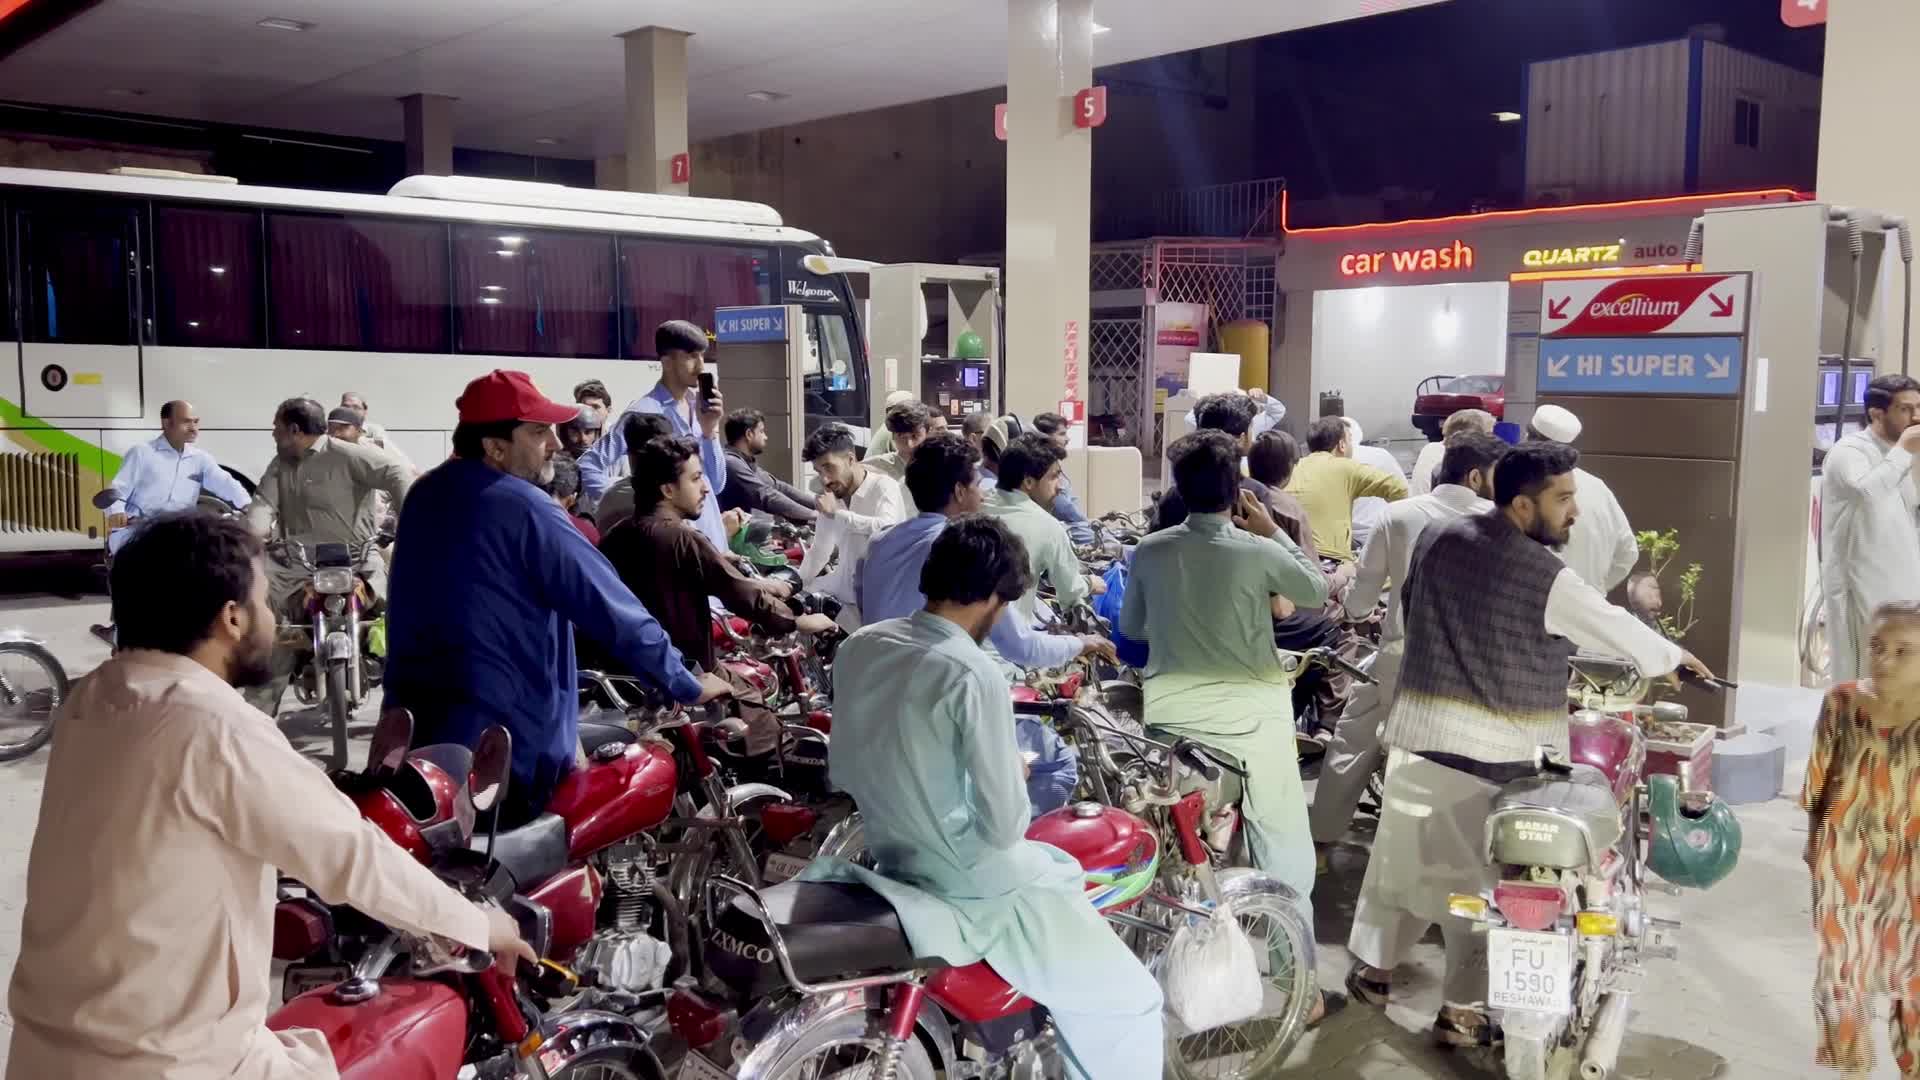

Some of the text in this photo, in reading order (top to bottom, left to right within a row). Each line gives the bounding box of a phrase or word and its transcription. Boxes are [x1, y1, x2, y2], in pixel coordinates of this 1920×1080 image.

[1083, 97, 1095, 118] 5
[1340, 240, 1474, 276] car wash
[1522, 244, 1621, 266] QUARTZ
[1633, 244, 1677, 260] auto
[1589, 297, 1680, 320] excellium
[741, 317, 770, 332] SUPER
[1577, 355, 1695, 376] HI SUPER
[711, 927, 774, 964] ZXMCO
[1512, 948, 1545, 970] FU
[1493, 991, 1563, 1009] PESHAWA
